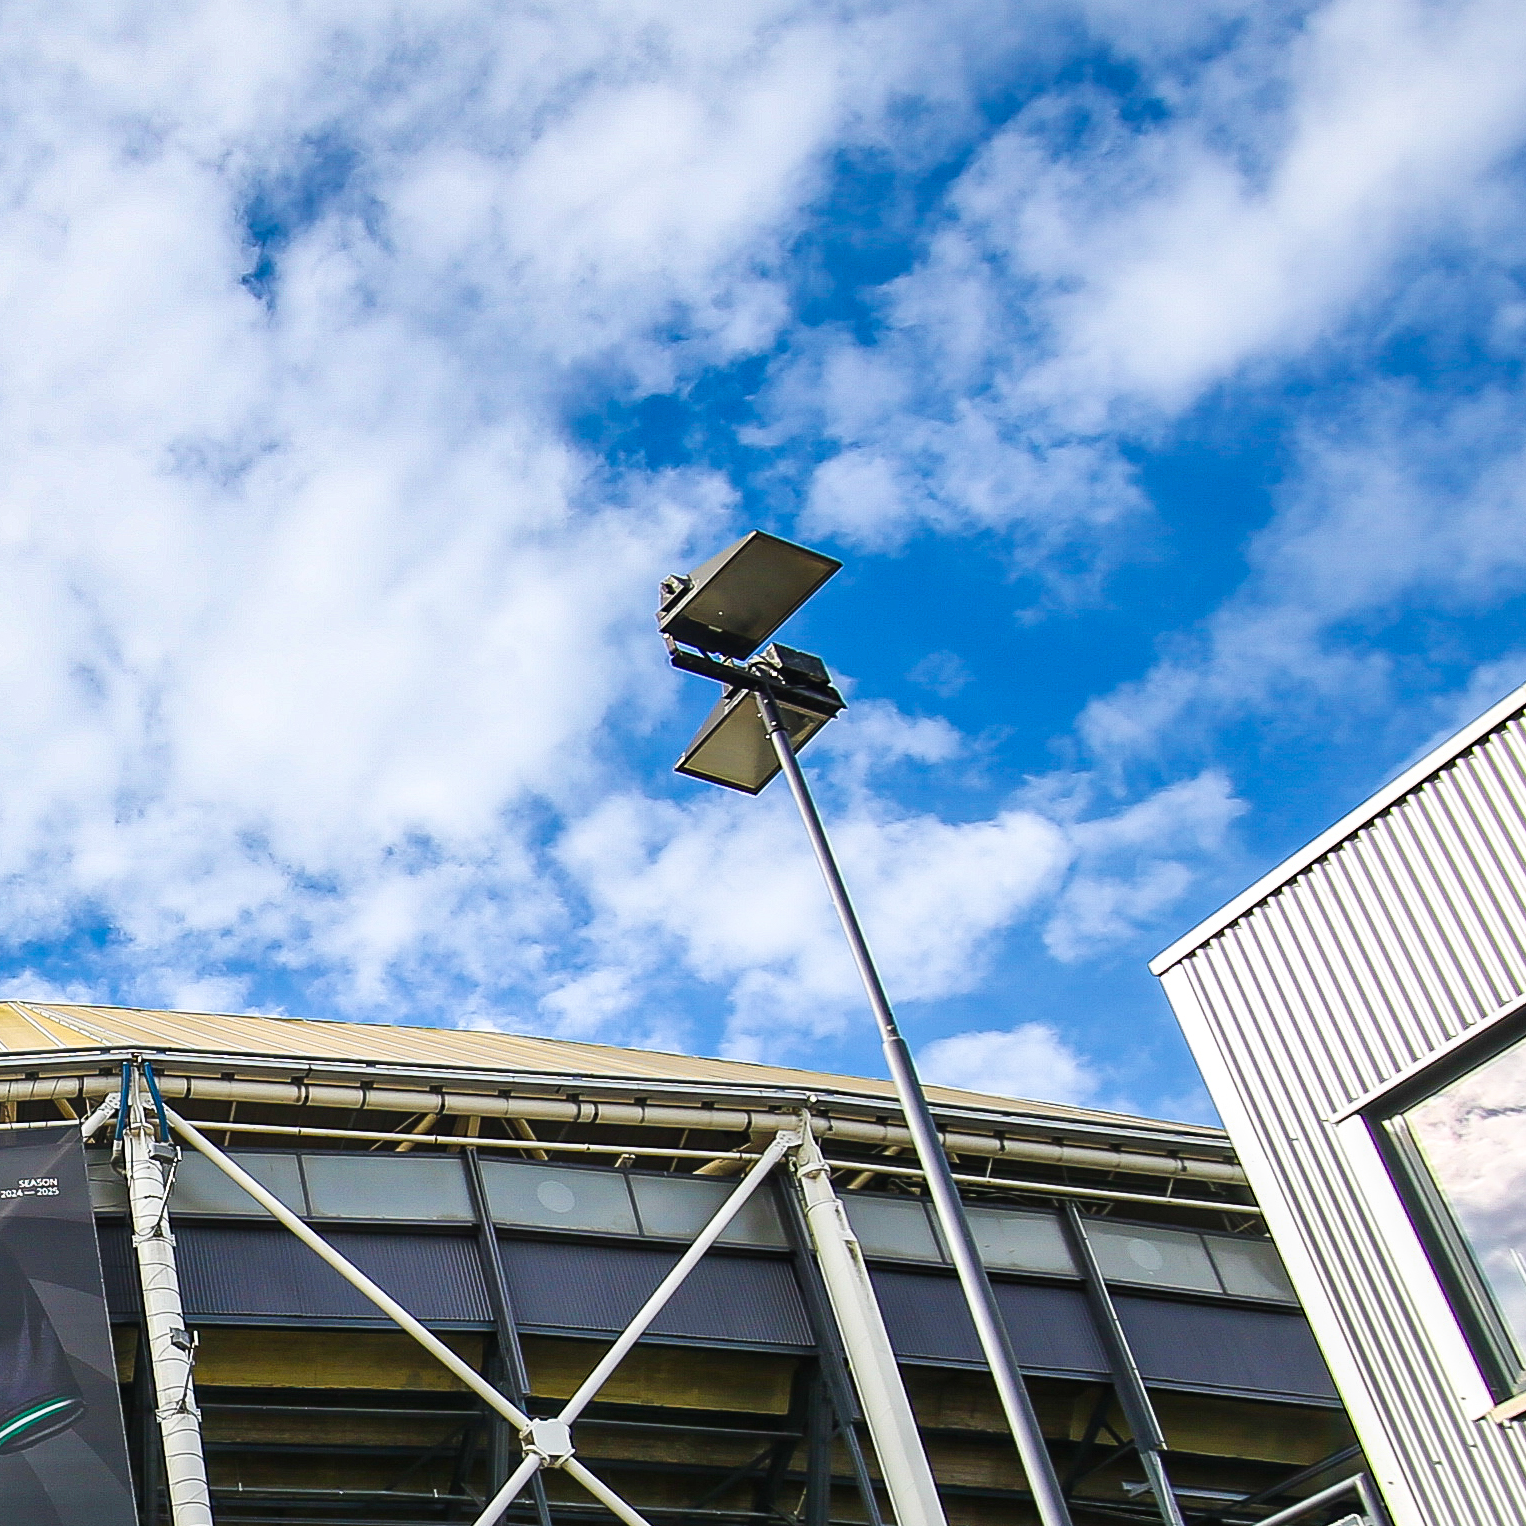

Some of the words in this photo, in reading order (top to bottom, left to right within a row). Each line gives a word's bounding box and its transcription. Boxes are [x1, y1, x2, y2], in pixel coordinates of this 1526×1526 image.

[19, 1178, 58, 1188] SEASON
[0, 1189, 24, 1199] 2024
[36, 1187, 59, 1196] 2025
